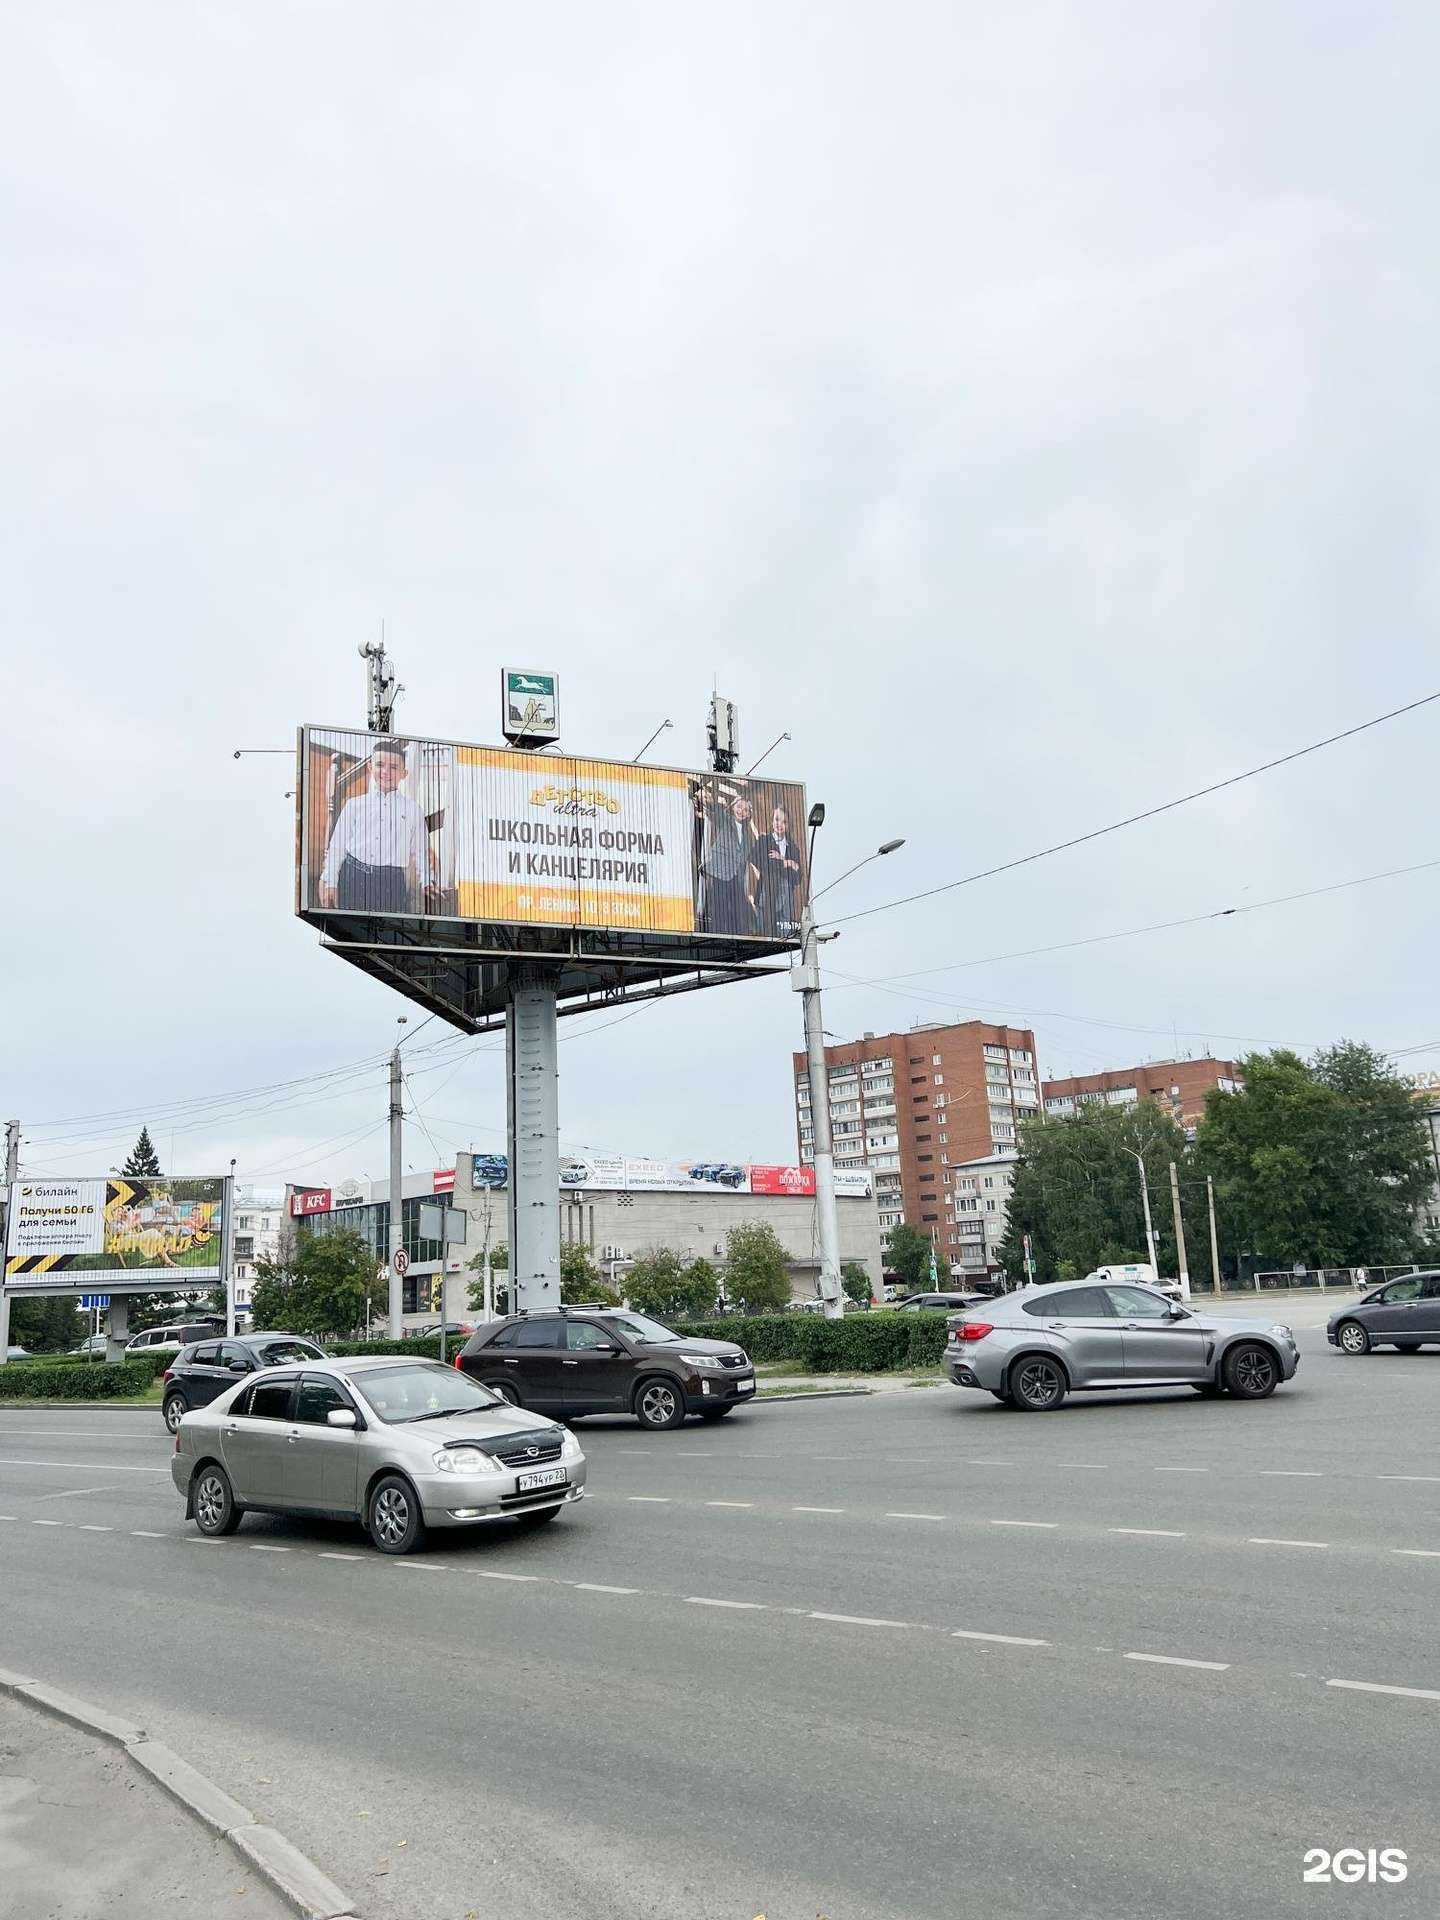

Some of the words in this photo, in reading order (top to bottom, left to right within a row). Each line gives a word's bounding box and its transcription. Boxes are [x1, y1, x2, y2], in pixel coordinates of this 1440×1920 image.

[554, 800, 598, 817] ultra
[488, 818, 593, 849] ШКОЛЬНАЯ
[598, 829, 664, 855] ФОРМА
[508, 851, 520, 874] И
[526, 852, 648, 885] КАНЦЕЛЯРИЯ
[35, 1187, 78, 1197] билайн
[306, 1194, 326, 1208] KFC
[20, 1206, 61, 1217] Получи
[64, 1205, 78, 1214] 50
[81, 1205, 94, 1214] Гб
[19, 1220, 39, 1228] для
